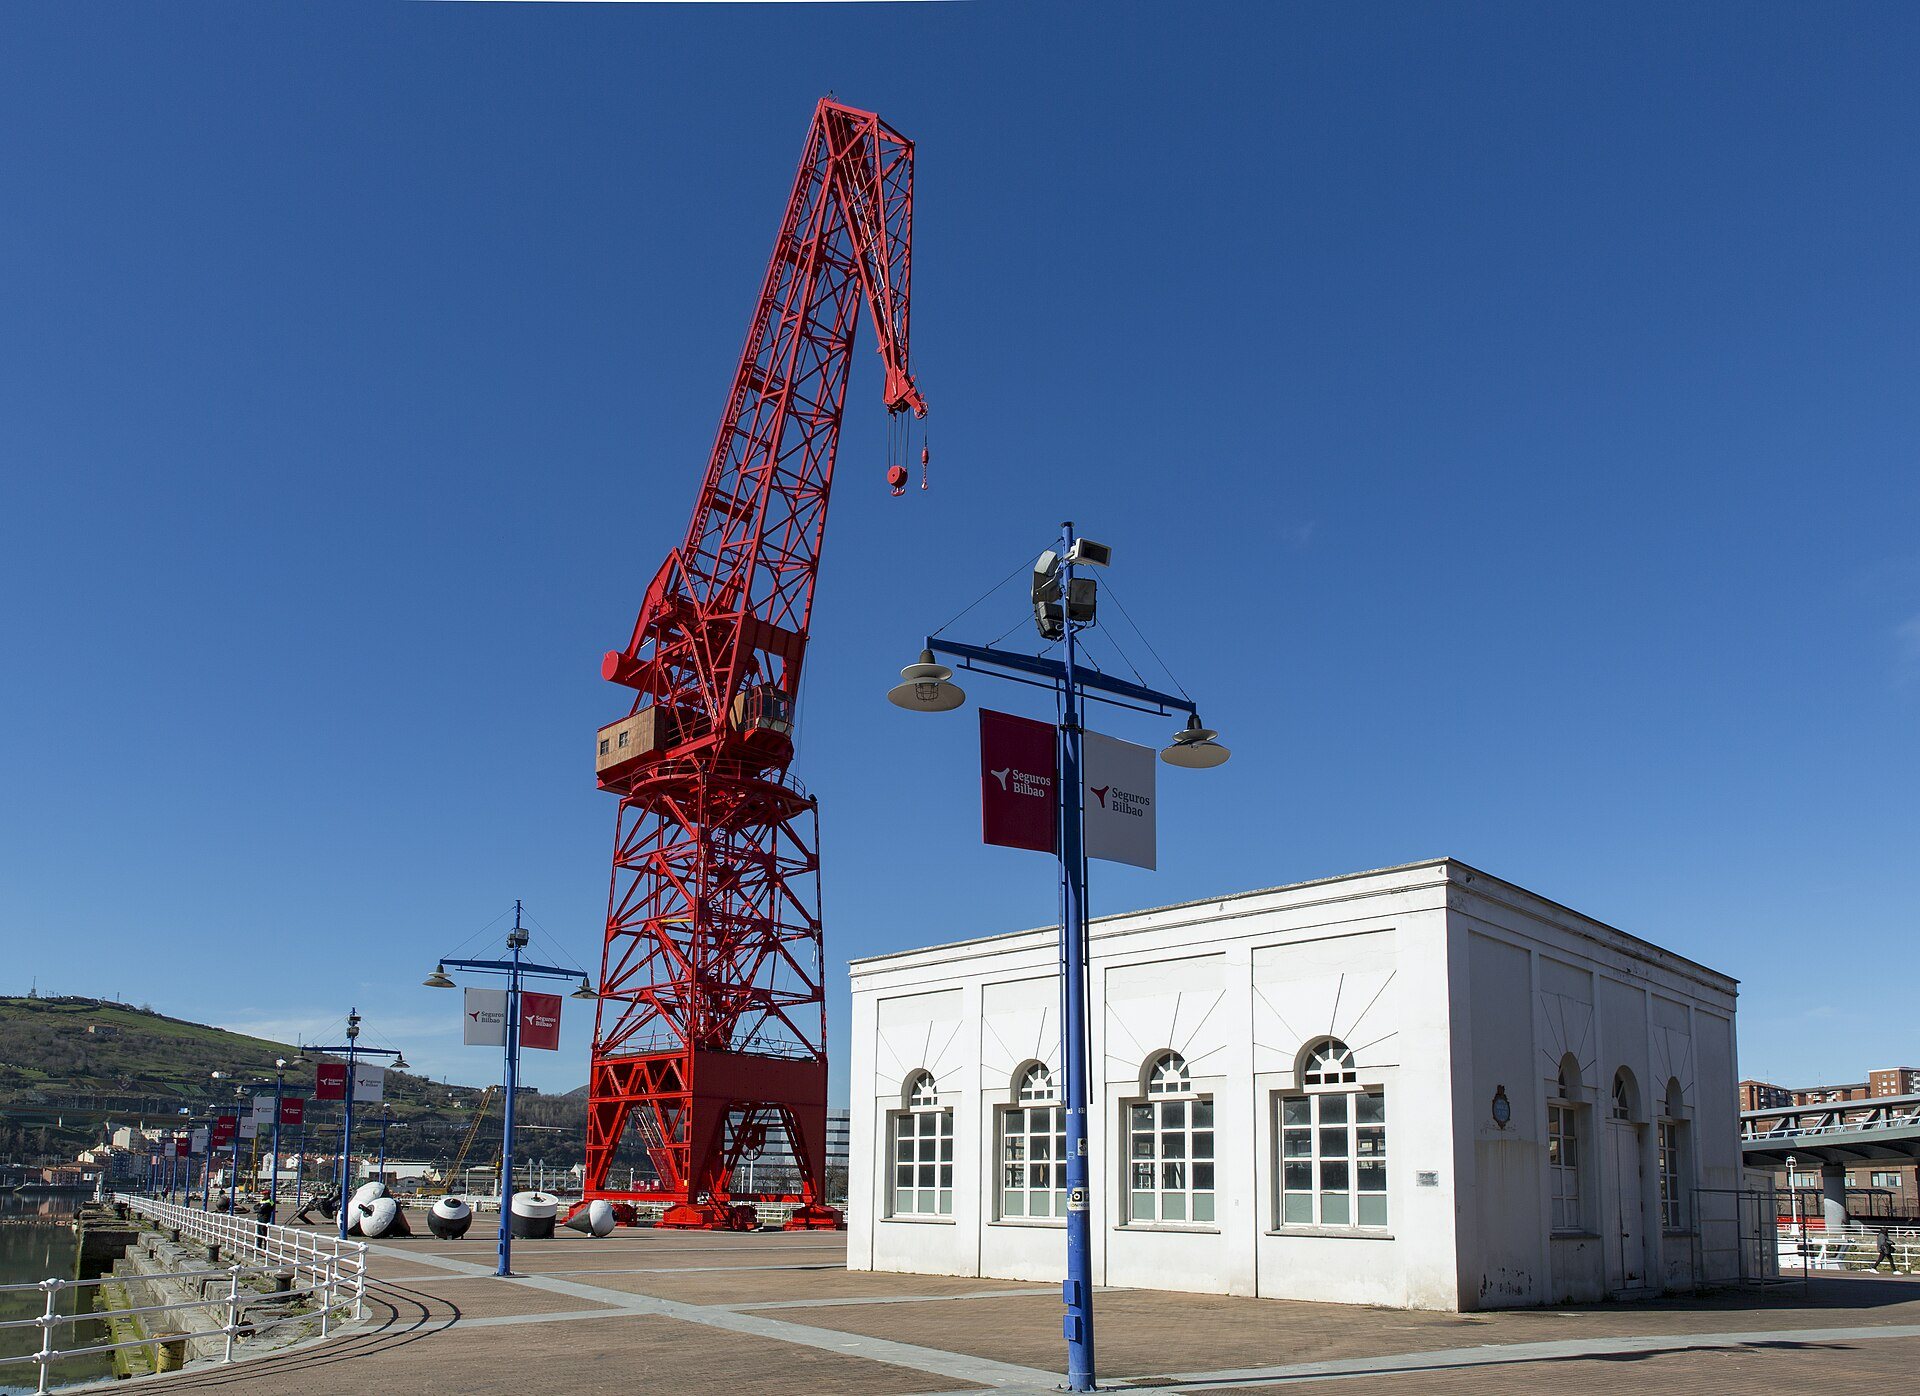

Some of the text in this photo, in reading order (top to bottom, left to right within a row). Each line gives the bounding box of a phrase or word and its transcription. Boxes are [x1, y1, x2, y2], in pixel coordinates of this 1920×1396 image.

[1012, 769, 1051, 786] Seguros
[1013, 782, 1045, 798] Bilbao
[1111, 787, 1151, 806] Seguros
[1112, 801, 1143, 817] Bilbao
